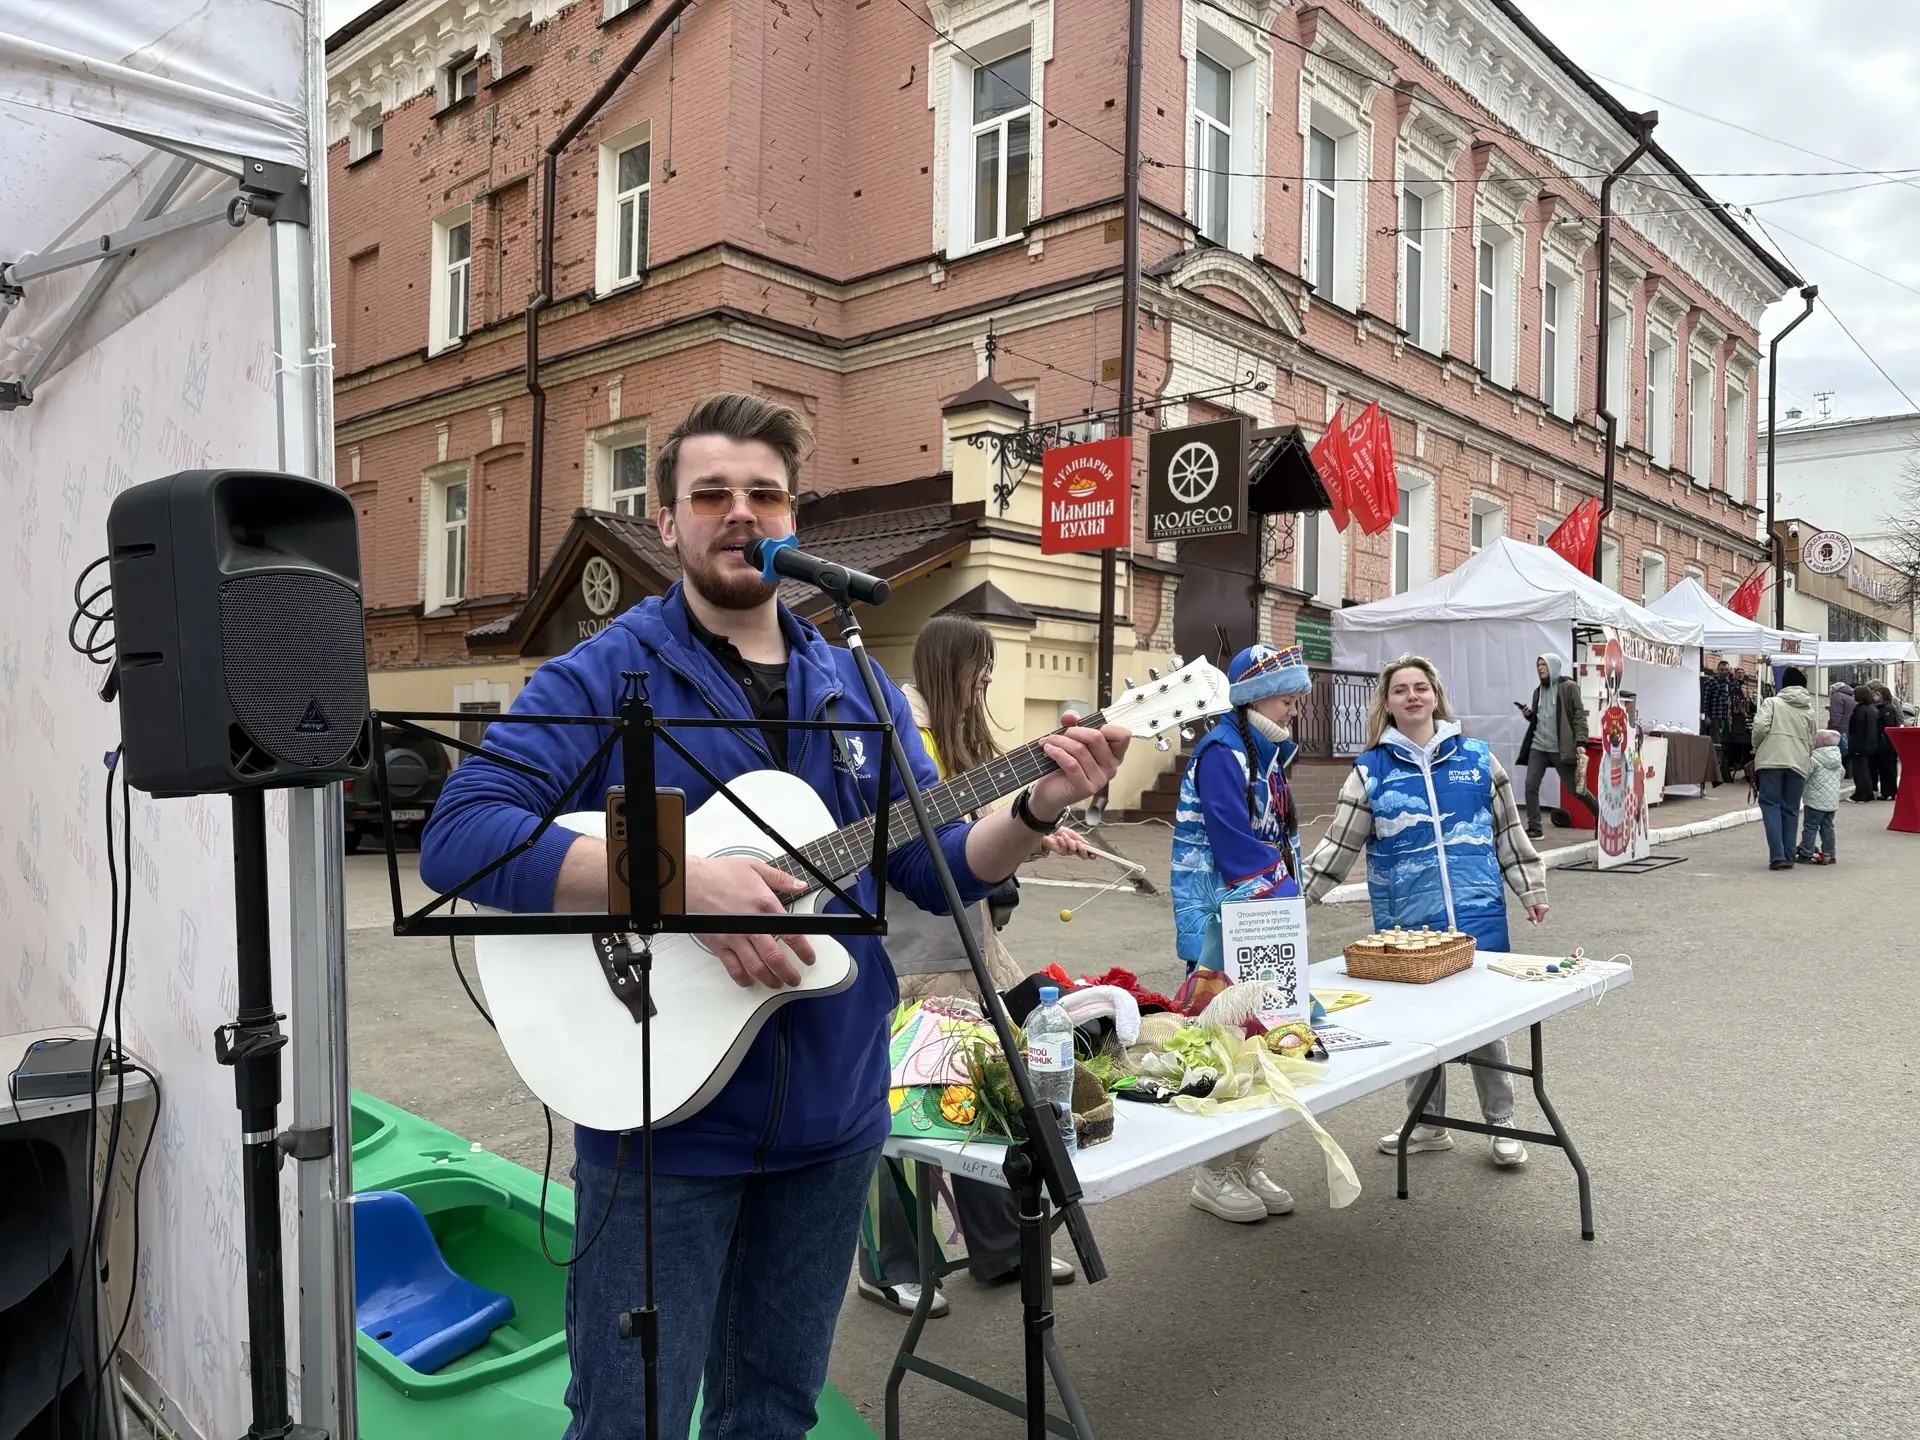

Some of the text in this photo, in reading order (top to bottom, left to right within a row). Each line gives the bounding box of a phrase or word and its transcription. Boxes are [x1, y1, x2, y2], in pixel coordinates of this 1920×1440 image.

[1053, 457, 1114, 488] КУЛИНАРИЯ
[1153, 505, 1233, 531] КОЛЕСО
[1805, 533, 1850, 559] ШОКОЛАДНИЦА
[1237, 909, 1278, 918] Отсканируйте
[1244, 933, 1277, 941] последним
[1261, 923, 1301, 933] комментарий
